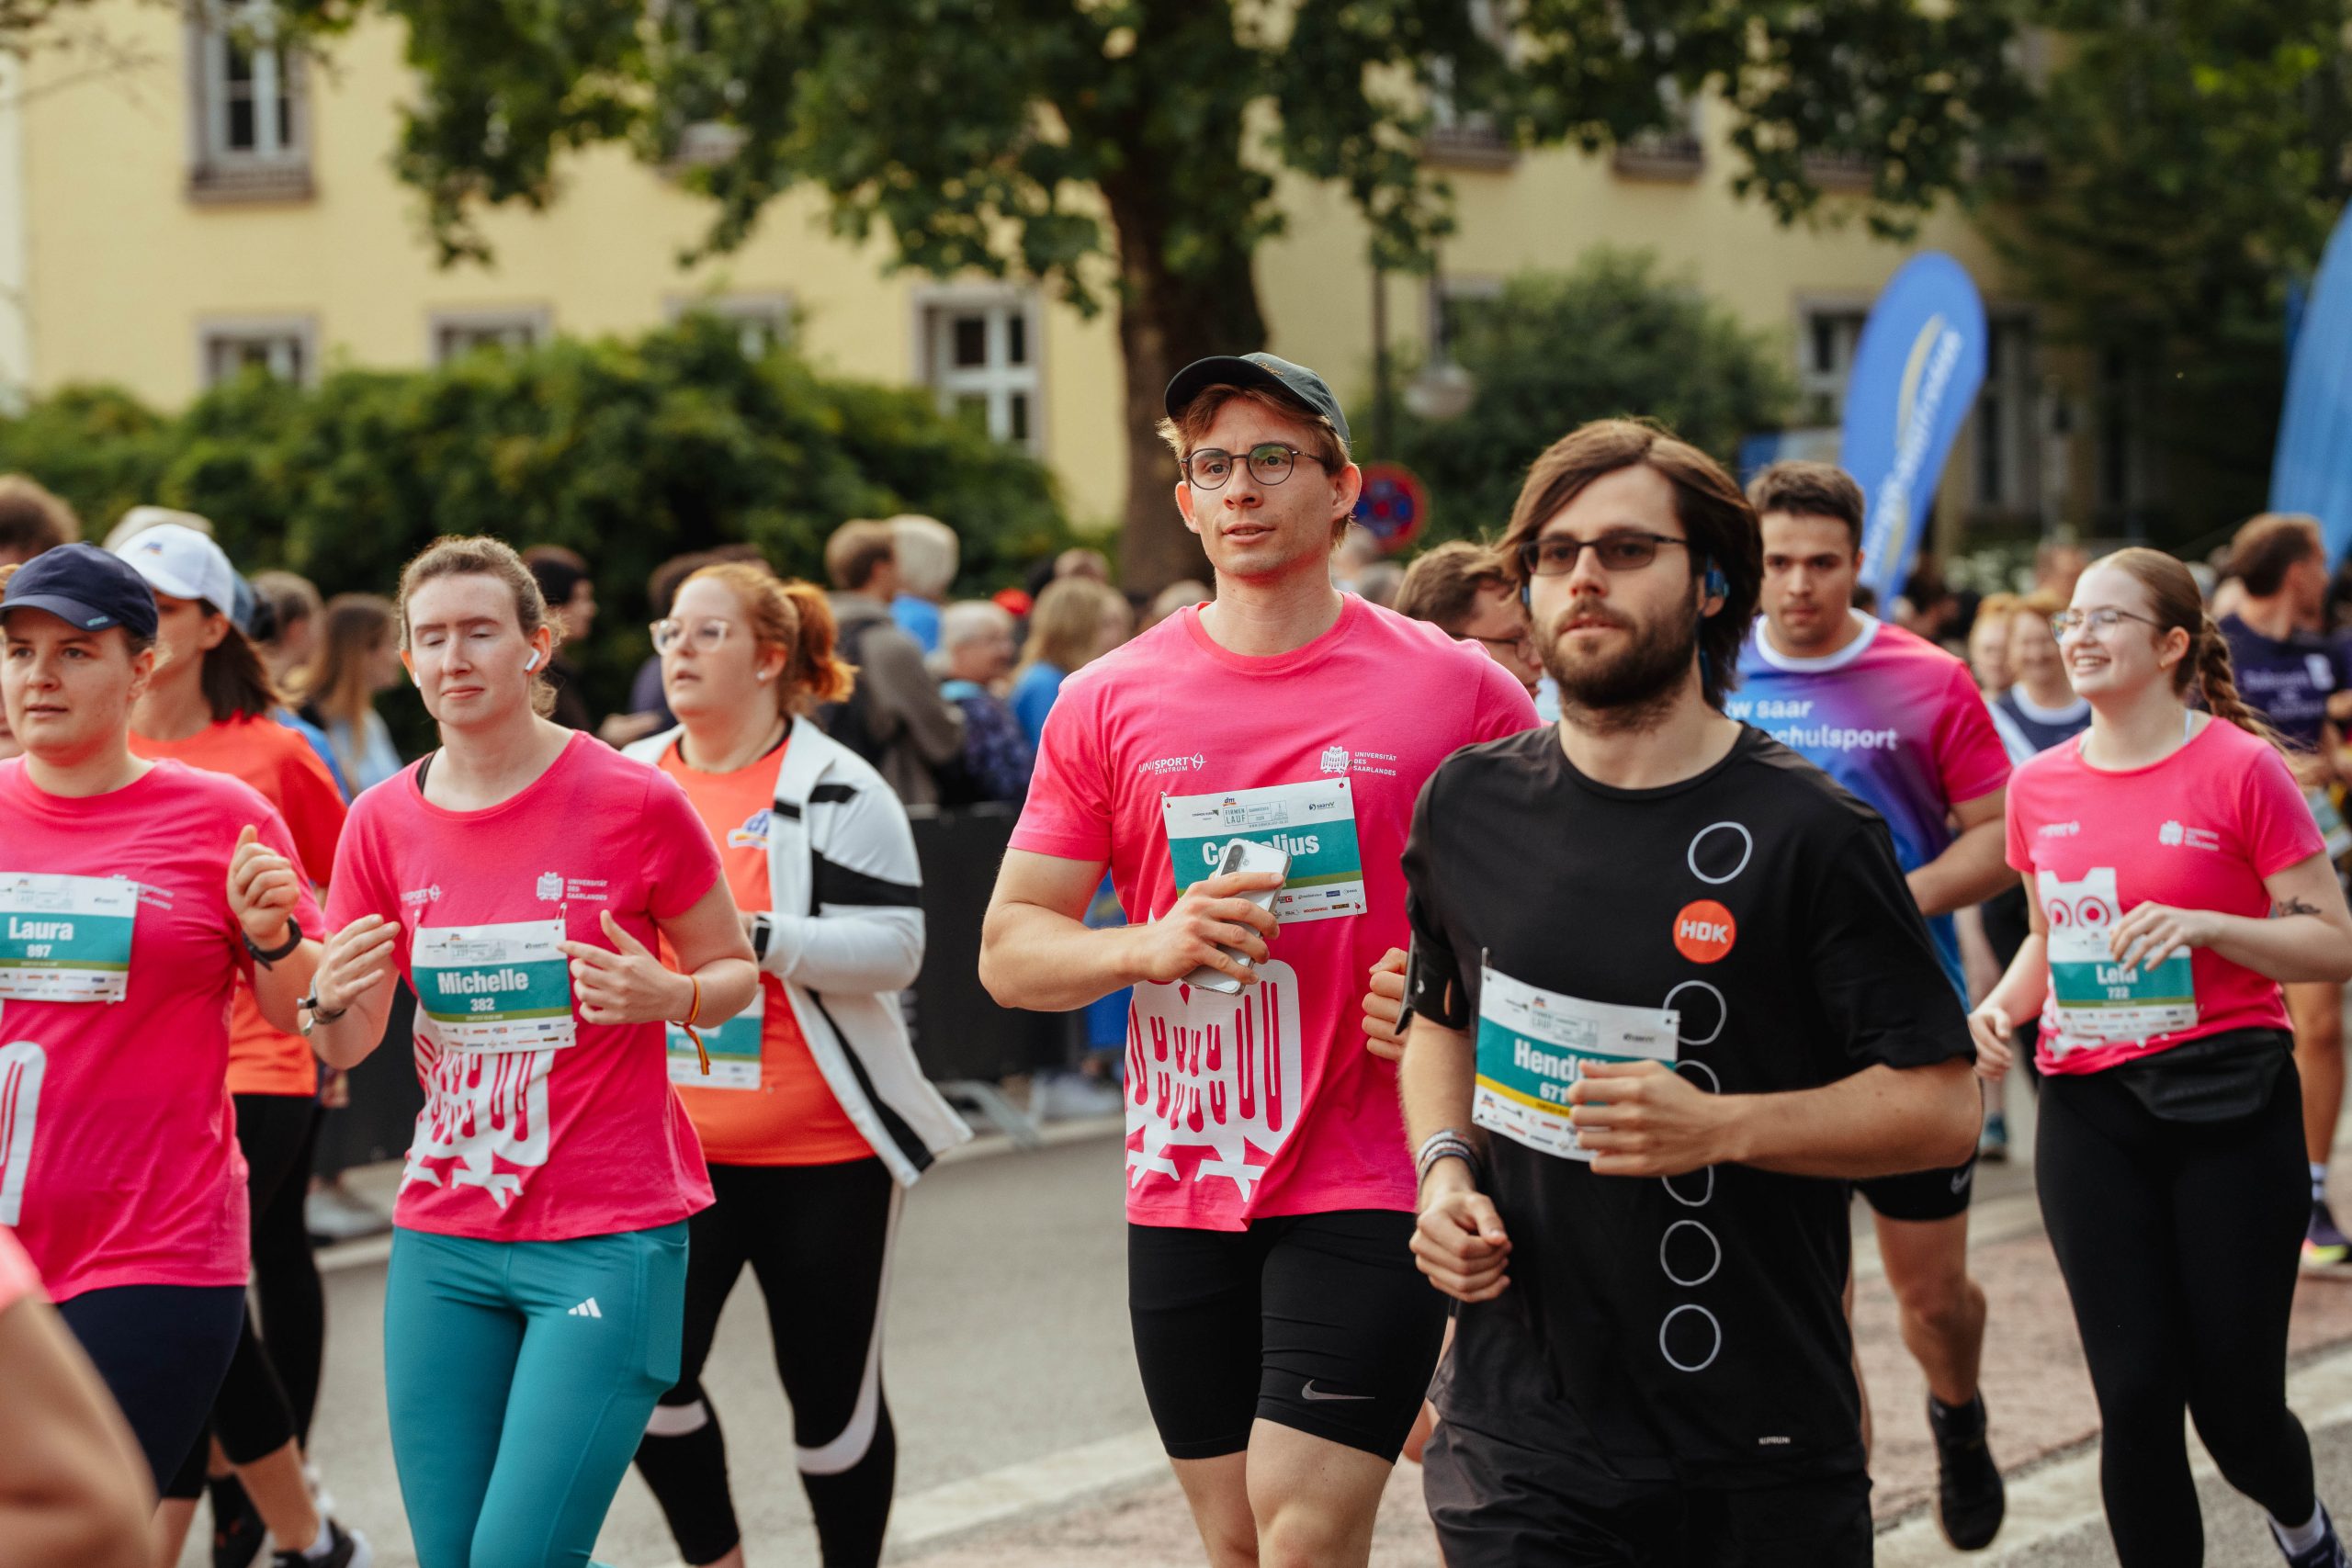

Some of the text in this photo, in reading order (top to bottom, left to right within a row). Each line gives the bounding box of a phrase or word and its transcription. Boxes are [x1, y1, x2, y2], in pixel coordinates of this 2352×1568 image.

[1757, 700, 1814, 718] saar
[1354, 751, 1396, 761] UNIVERSITÄT
[1138, 756, 1189, 773] UNISPORT
[1154, 765, 1188, 775] ZENTRUM
[1352, 765, 1396, 776] SAARLANDES
[1225, 807, 1245, 816] FIRMEN
[1226, 815, 1246, 824] LAUF
[1202, 833, 1320, 865] Clius
[9, 916, 74, 941] Laura
[436, 968, 529, 995] Michelle
[469, 998, 495, 1012] 382
[1513, 1037, 1608, 1082] Hend
